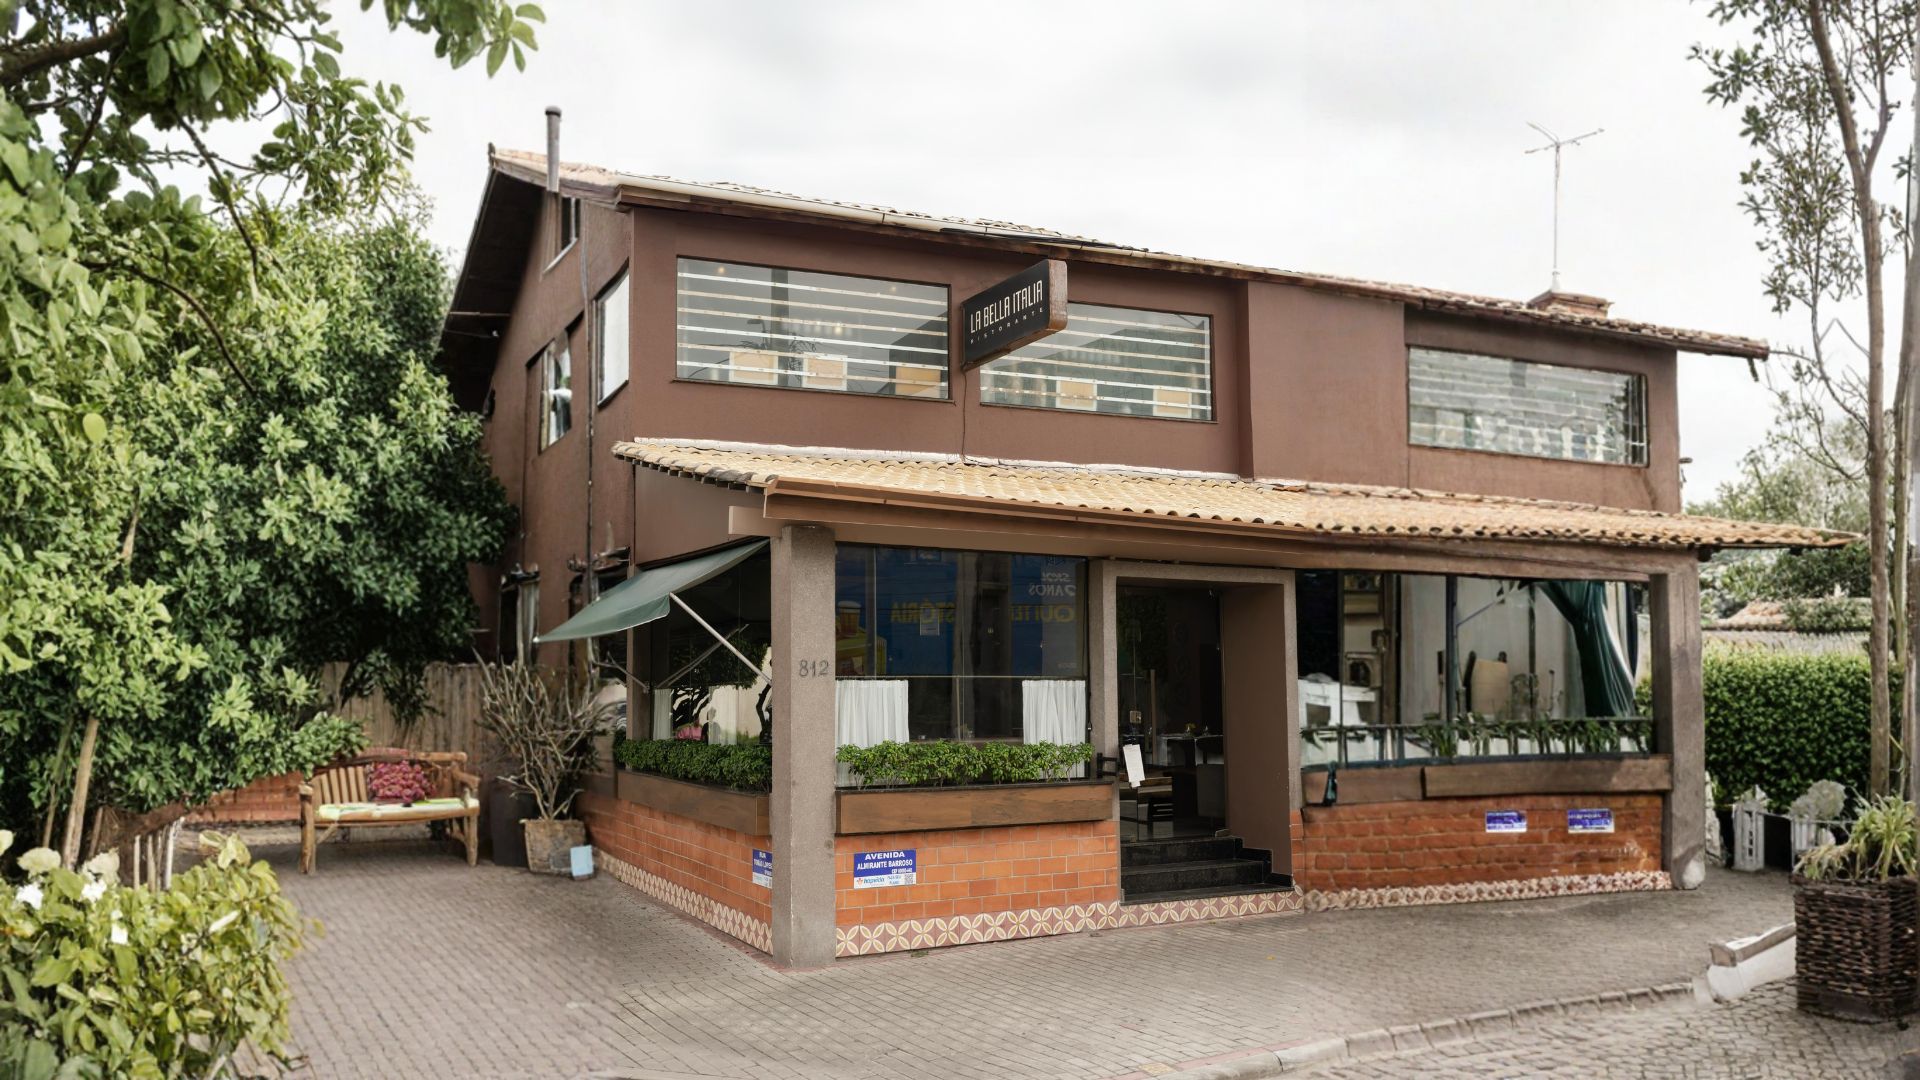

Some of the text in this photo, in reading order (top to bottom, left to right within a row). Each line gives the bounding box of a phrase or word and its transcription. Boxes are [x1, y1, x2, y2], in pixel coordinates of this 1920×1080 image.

[970, 279, 1043, 334] LA BELLA ITALIA
[970, 307, 1043, 345] RISTORANTE
[799, 659, 829, 678] 812
[857, 861, 888, 871] ALMIRANTE
[888, 859, 913, 868] BARROSO
[865, 851, 905, 861] AVENIDA
